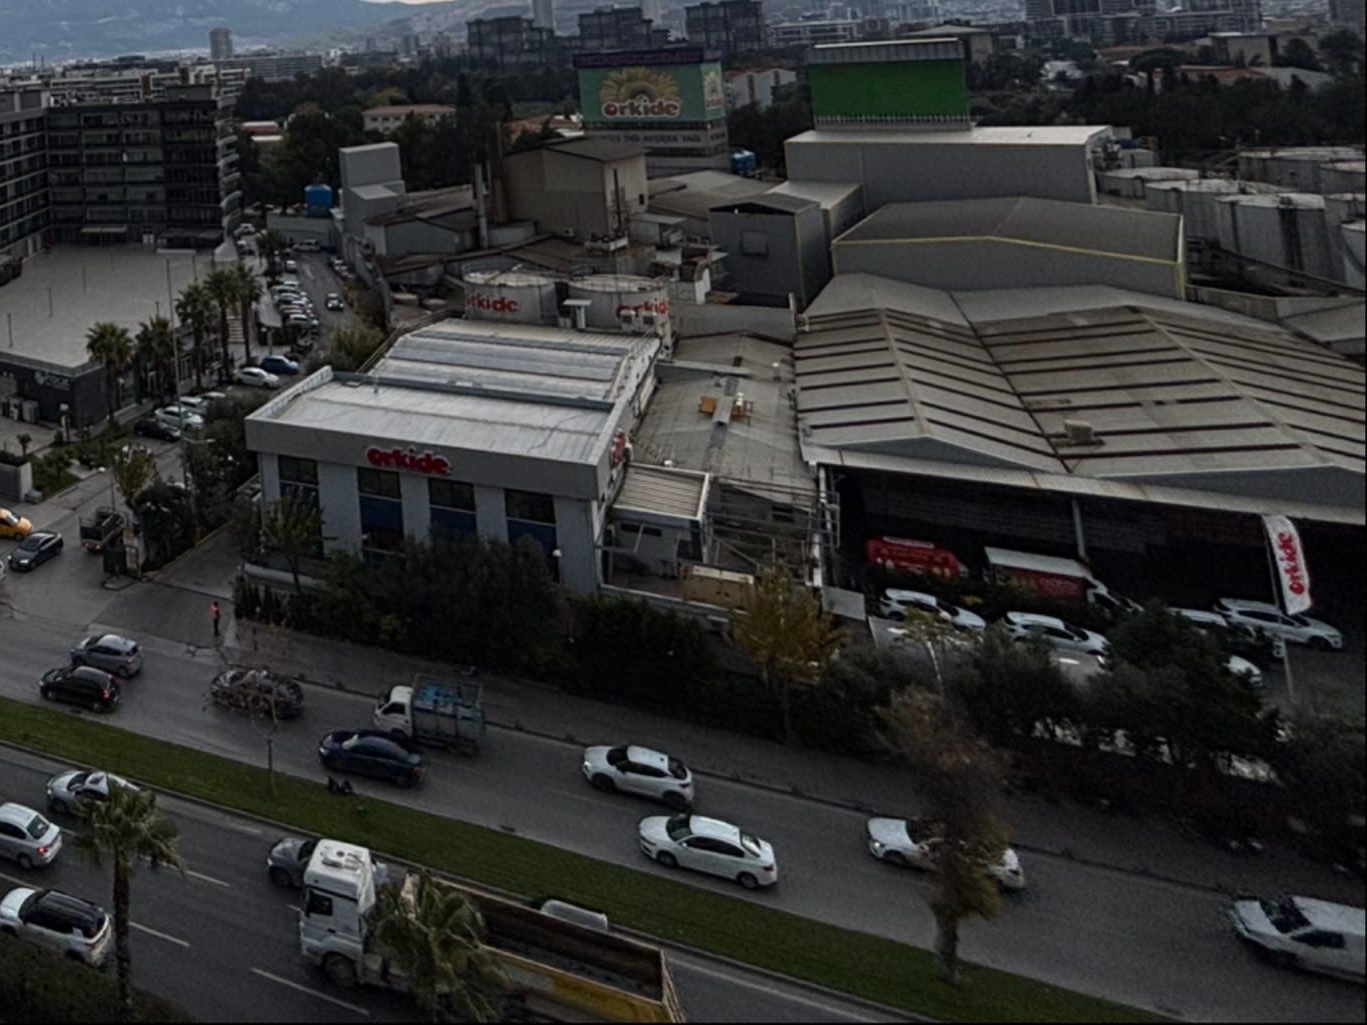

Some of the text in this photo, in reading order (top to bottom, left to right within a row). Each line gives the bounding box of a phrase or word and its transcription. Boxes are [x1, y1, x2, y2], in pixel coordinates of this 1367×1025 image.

[602, 98, 680, 117] orkide
[366, 446, 451, 476] orkide
[1275, 531, 1306, 595] orkide
